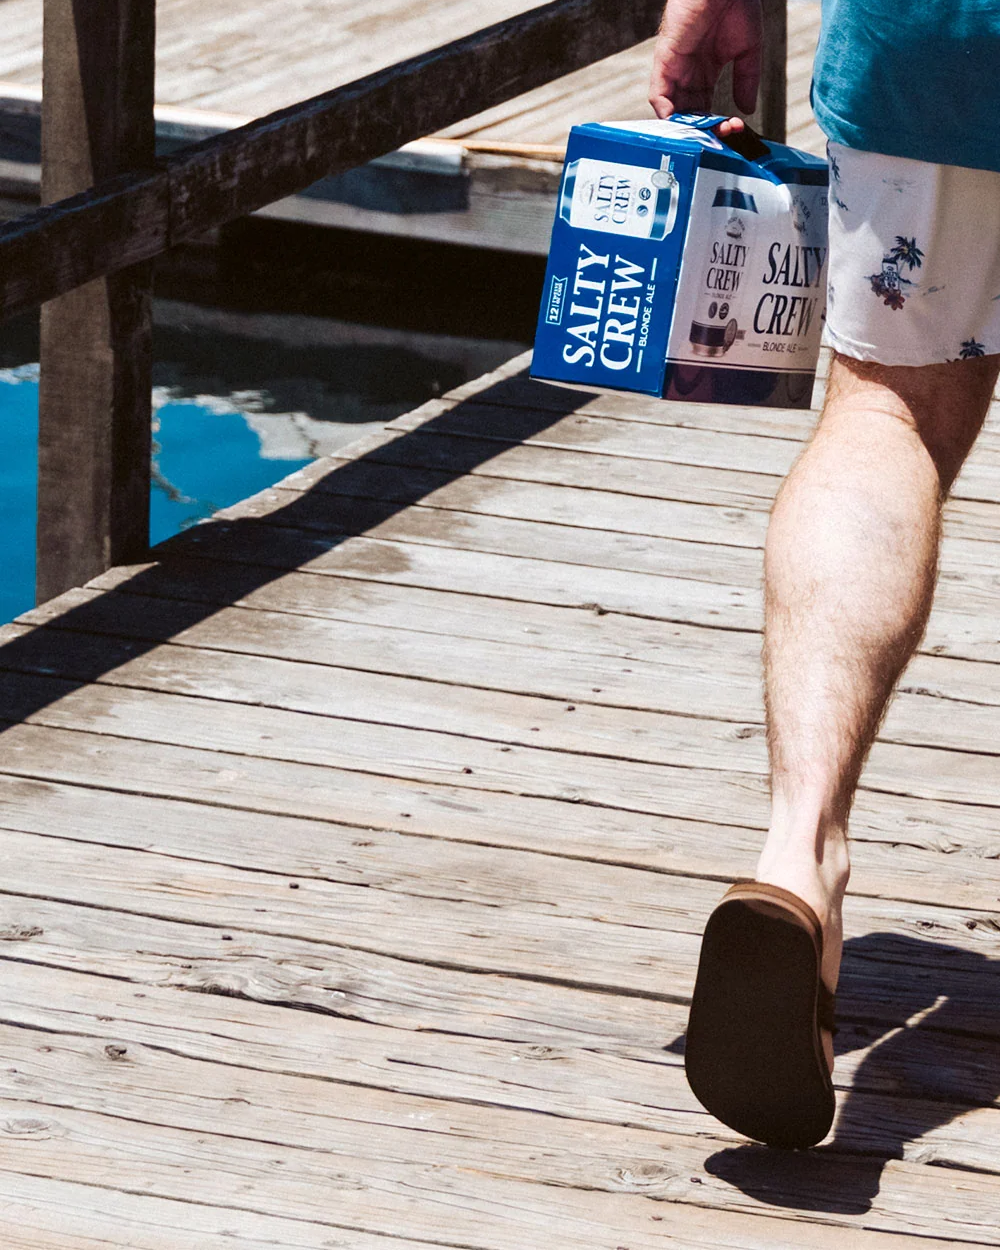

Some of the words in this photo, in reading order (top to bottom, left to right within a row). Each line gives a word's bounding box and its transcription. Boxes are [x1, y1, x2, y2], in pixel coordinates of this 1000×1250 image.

[594, 171, 616, 223] SALTY
[611, 176, 631, 224] CREW
[710, 241, 750, 268] SALTY
[762, 242, 827, 288] SALTY
[706, 267, 743, 292] CREW
[549, 307, 559, 322] 12
[562, 243, 610, 367] SALTY
[600, 254, 645, 370] CREW
[638, 306, 652, 347] BLONDE
[645, 283, 656, 304] ALE
[753, 293, 818, 337] CREW
